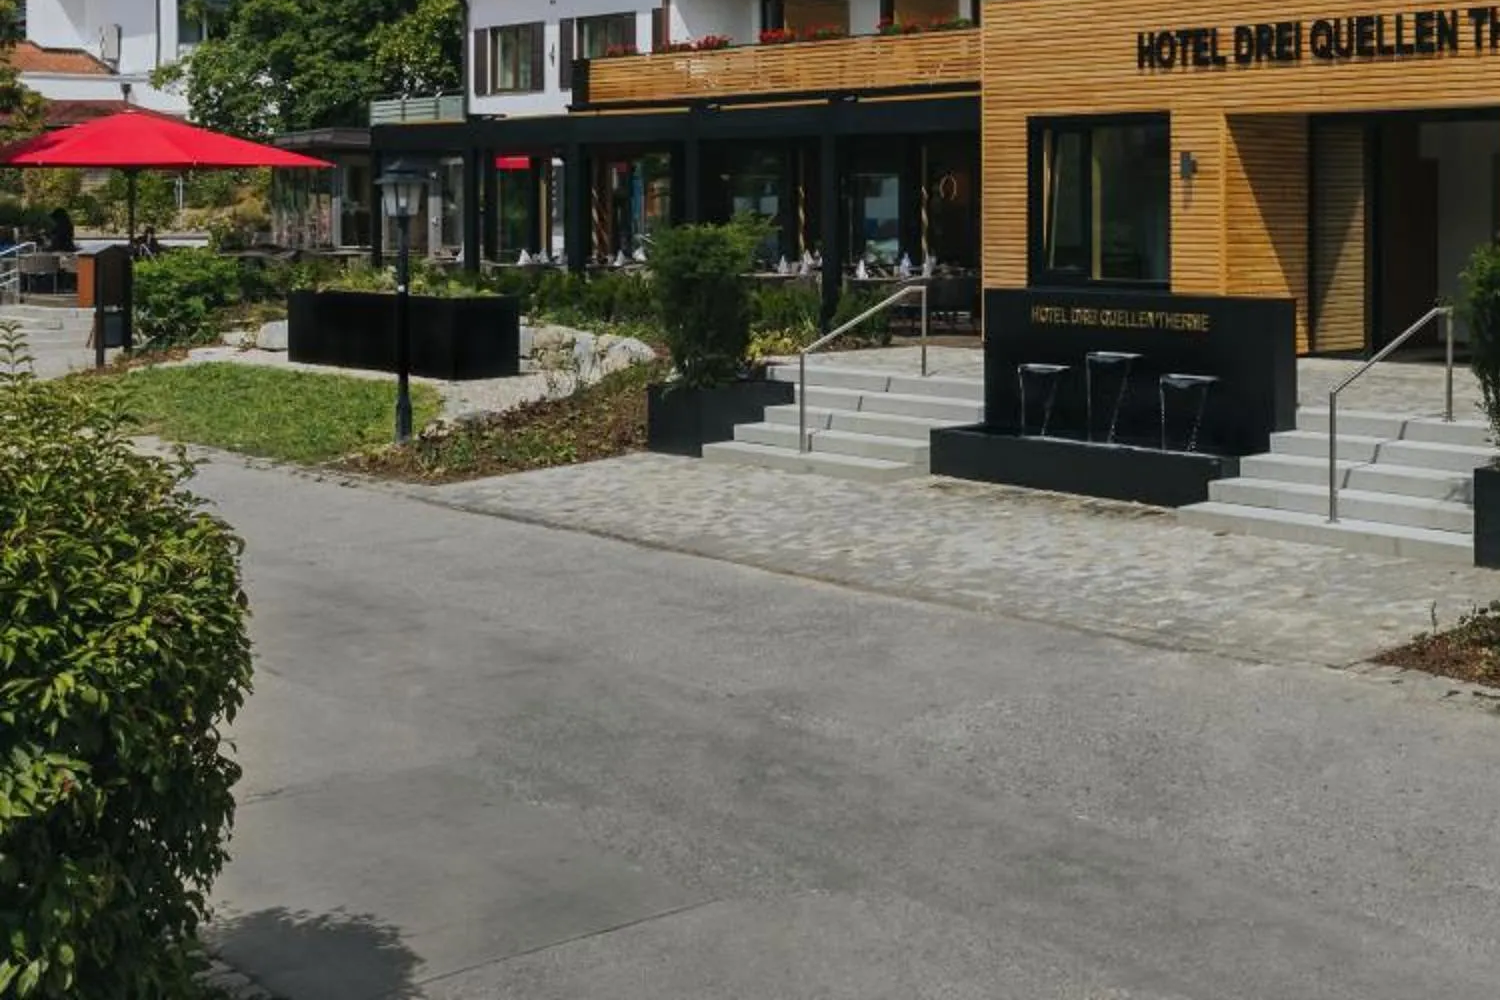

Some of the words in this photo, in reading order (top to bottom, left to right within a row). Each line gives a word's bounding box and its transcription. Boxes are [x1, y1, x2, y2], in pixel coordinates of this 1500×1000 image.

[1137, 28, 1226, 70] HOTEL
[1234, 20, 1301, 64] DREI
[1310, 9, 1458, 60] QUELLEN
[1031, 306, 1067, 324] HOTEL
[1101, 309, 1154, 329] QUELLEN
